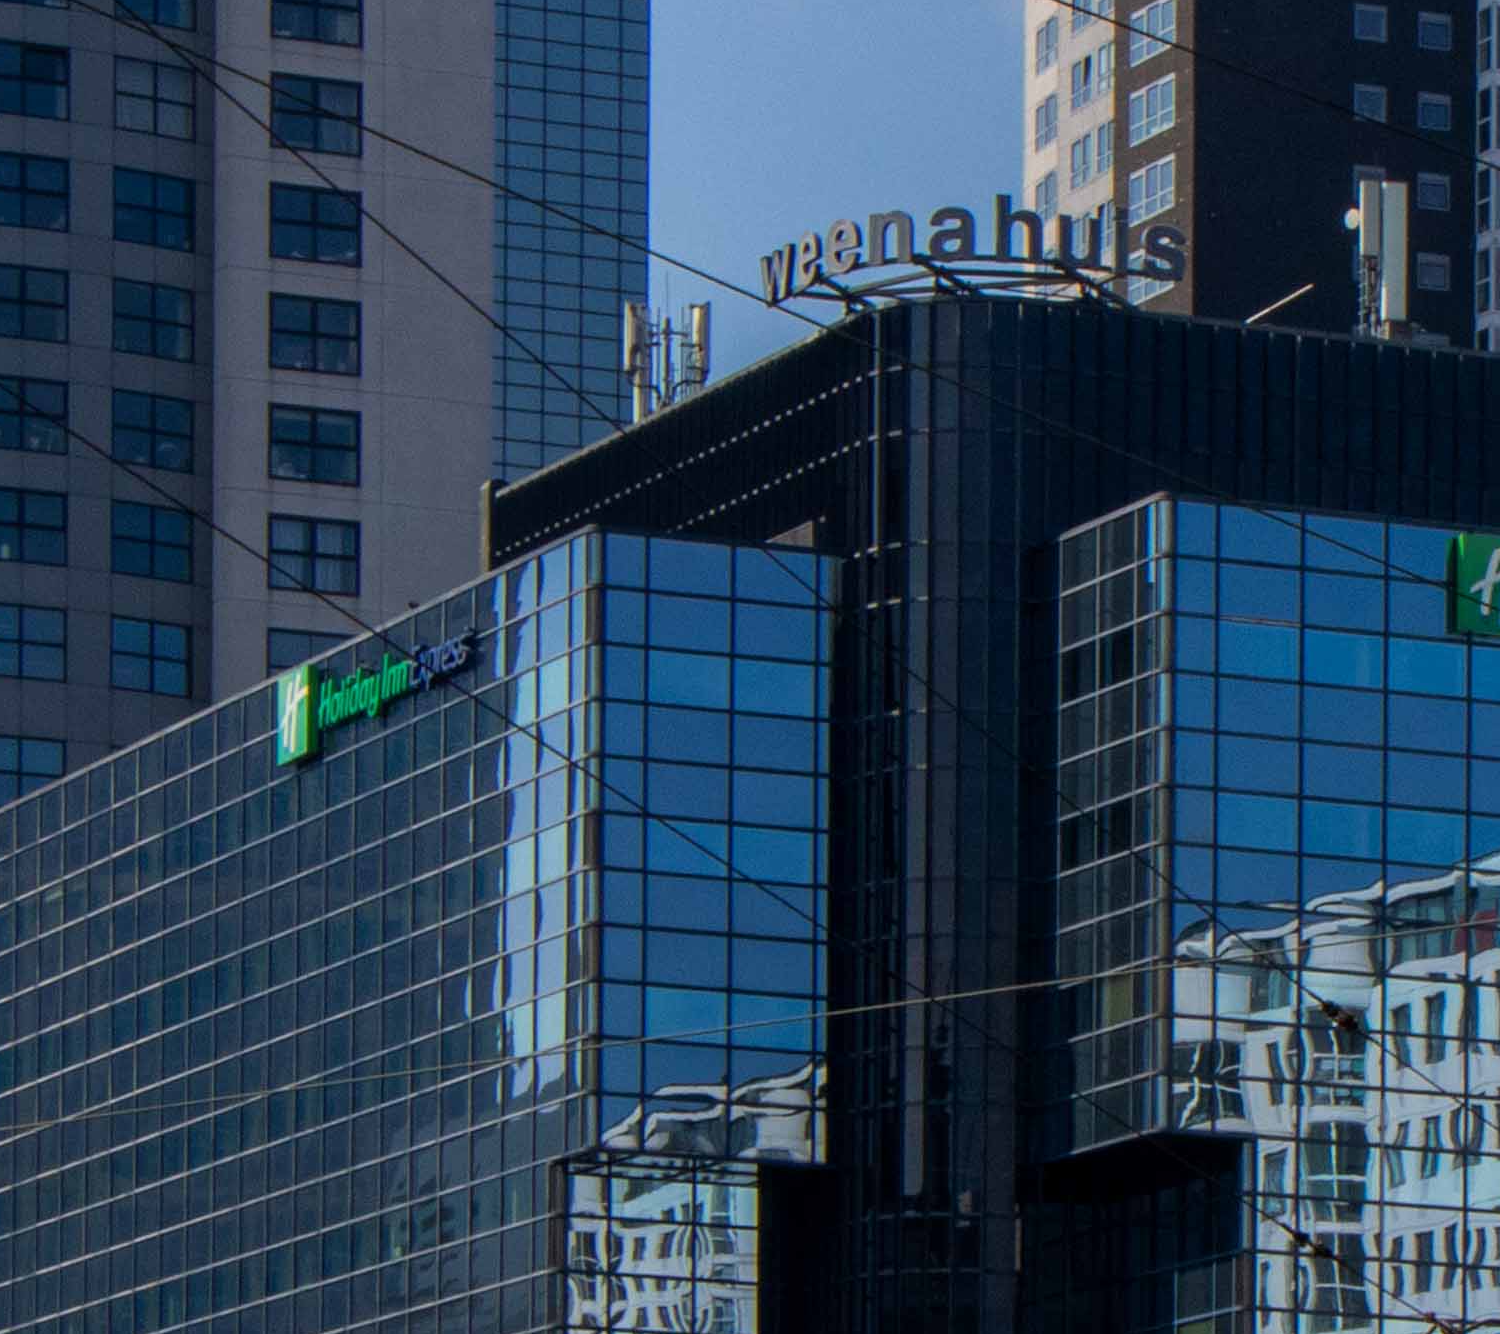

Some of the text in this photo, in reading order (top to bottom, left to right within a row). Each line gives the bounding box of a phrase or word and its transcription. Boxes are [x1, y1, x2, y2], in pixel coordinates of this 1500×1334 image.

[760, 194, 1188, 308] weenahuis
[318, 667, 382, 731] Holiday
[381, 652, 411, 700] Inn
